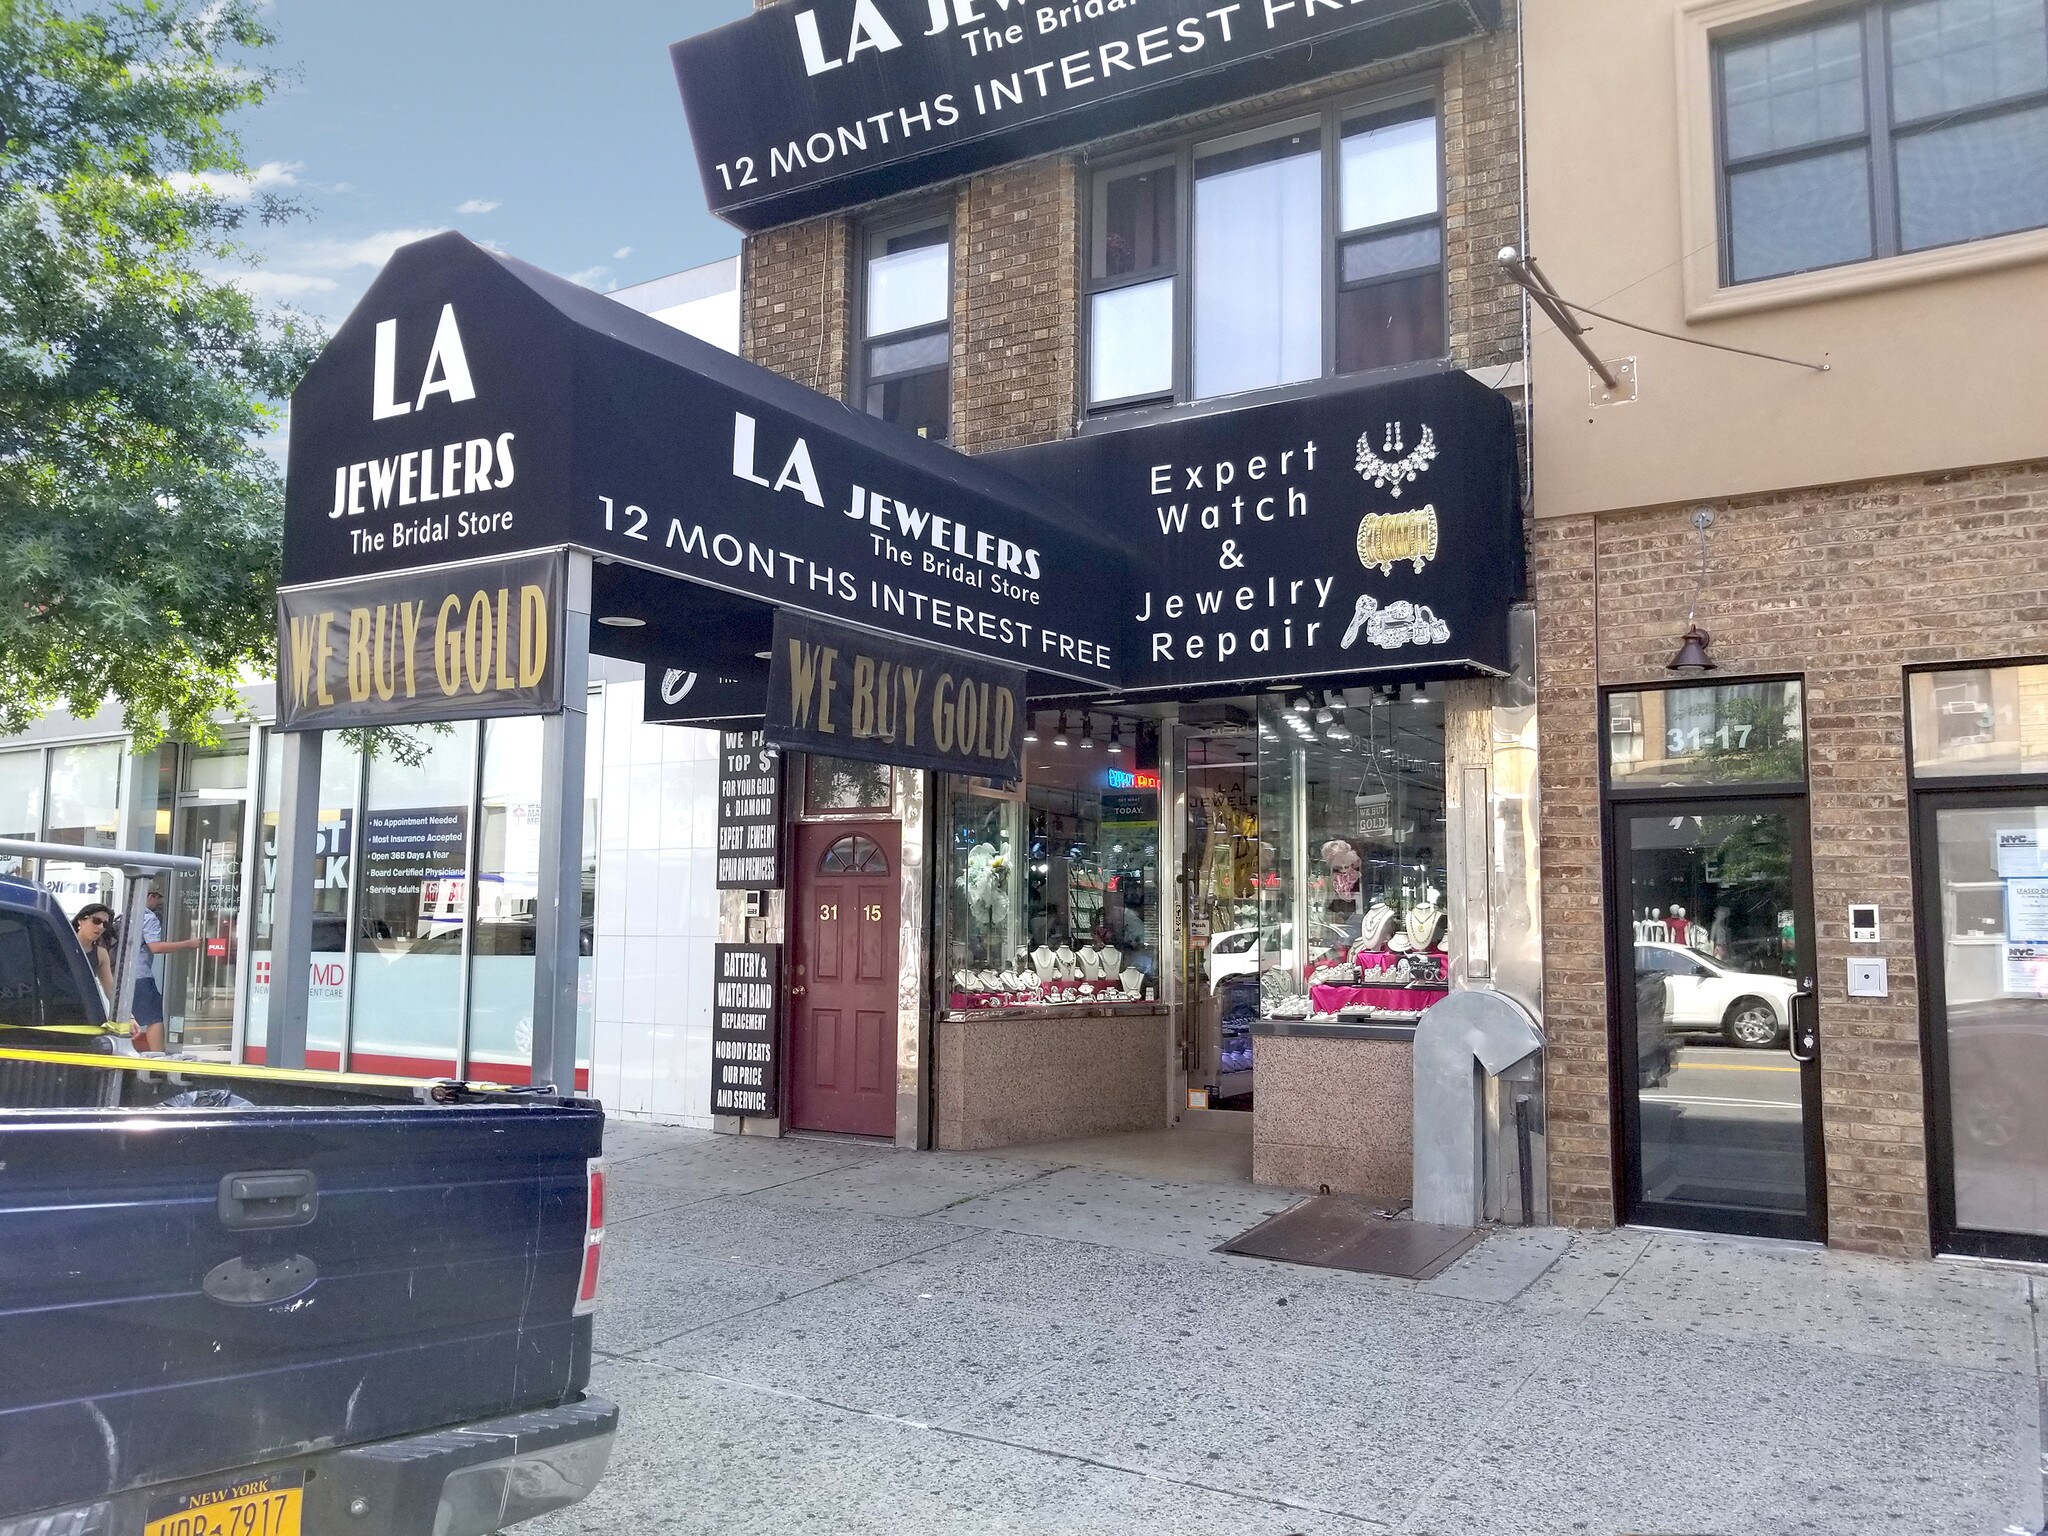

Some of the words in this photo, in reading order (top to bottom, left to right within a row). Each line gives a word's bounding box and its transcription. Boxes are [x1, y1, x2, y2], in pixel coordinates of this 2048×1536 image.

[794, 0, 903, 77] LA
[961, 24, 1023, 57] The
[1036, 0, 1138, 35] Brida
[715, 156, 759, 191] 12
[770, 93, 959, 178] MONTHS
[973, 3, 1241, 116] INTEREST
[372, 302, 476, 421] LA
[732, 411, 825, 508] LA
[1150, 440, 1318, 497] Expert
[328, 432, 516, 519] JEWELERS
[1157, 487, 1308, 536] Watch
[350, 529, 385, 555] The
[392, 513, 449, 548] Bridal
[458, 508, 514, 538] Store
[843, 484, 1042, 581] JEWELERS
[1218, 539, 1246, 570] &
[598, 495, 650, 543] 12
[665, 517, 858, 603] MONTHS
[871, 580, 1033, 649] INTEREST
[1042, 629, 1112, 670] FREE
[869, 532, 913, 568] The
[922, 549, 983, 590] Bridal
[990, 573, 1042, 607] Store
[1135, 575, 1335, 622] Jewelry
[290, 610, 334, 709] WE
[348, 599, 424, 702] BUY
[434, 584, 548, 697] GOLD
[1152, 618, 1321, 663] Repair
[789, 638, 838, 735] WE
[851, 653, 925, 748] BUY
[933, 671, 1015, 762] GOLD
[725, 732, 744, 749] WE
[727, 754, 751, 772] TOP
[759, 749, 771, 773] $
[722, 780, 737, 797] FOR
[737, 778, 756, 797] YOUR
[756, 777, 775, 796] GOLD
[725, 803, 731, 817] &
[735, 798, 772, 817] DIAMOND
[373, 819, 383, 827] No
[383, 816, 428, 828] Appointment
[429, 815, 458, 824] Needed
[1360, 817, 1386, 830] GOLD
[372, 834, 389, 844] Most
[390, 834, 426, 843] Insurance
[427, 832, 462, 843] Accepted
[720, 825, 744, 850] EXPERT
[747, 824, 776, 850] JEWELRY
[371, 852, 389, 861] Open
[390, 851, 406, 860] 365
[407, 851, 425, 860] Days
[426, 851, 431, 859] A
[433, 850, 449, 859] Year
[719, 857, 737, 881] REPAIR
[370, 868, 391, 877] Board
[392, 867, 424, 877] Certified
[425, 867, 465, 878] Physicians
[369, 885, 396, 895] Serving
[397, 885, 420, 894] Adults
[819, 903, 838, 922] 31
[863, 904, 881, 922] 15
[724, 952, 760, 978] BATTERY
[760, 956, 768, 979] &
[324, 989, 343, 998] CARE
[718, 982, 748, 1008] WATCH
[749, 983, 772, 1009] BAND
[721, 1012, 767, 1031] REPLACEMENT
[715, 1040, 747, 1060] NOBODY
[747, 1042, 771, 1062] BEATS
[722, 1065, 738, 1084] OUR
[739, 1066, 762, 1086] PRICE
[717, 1088, 733, 1108] AND
[733, 1090, 766, 1111] SERVICE
[189, 1489, 228, 1509] NEW
[232, 1478, 270, 1498] YORK
[229, 1495, 288, 1536] 7917
